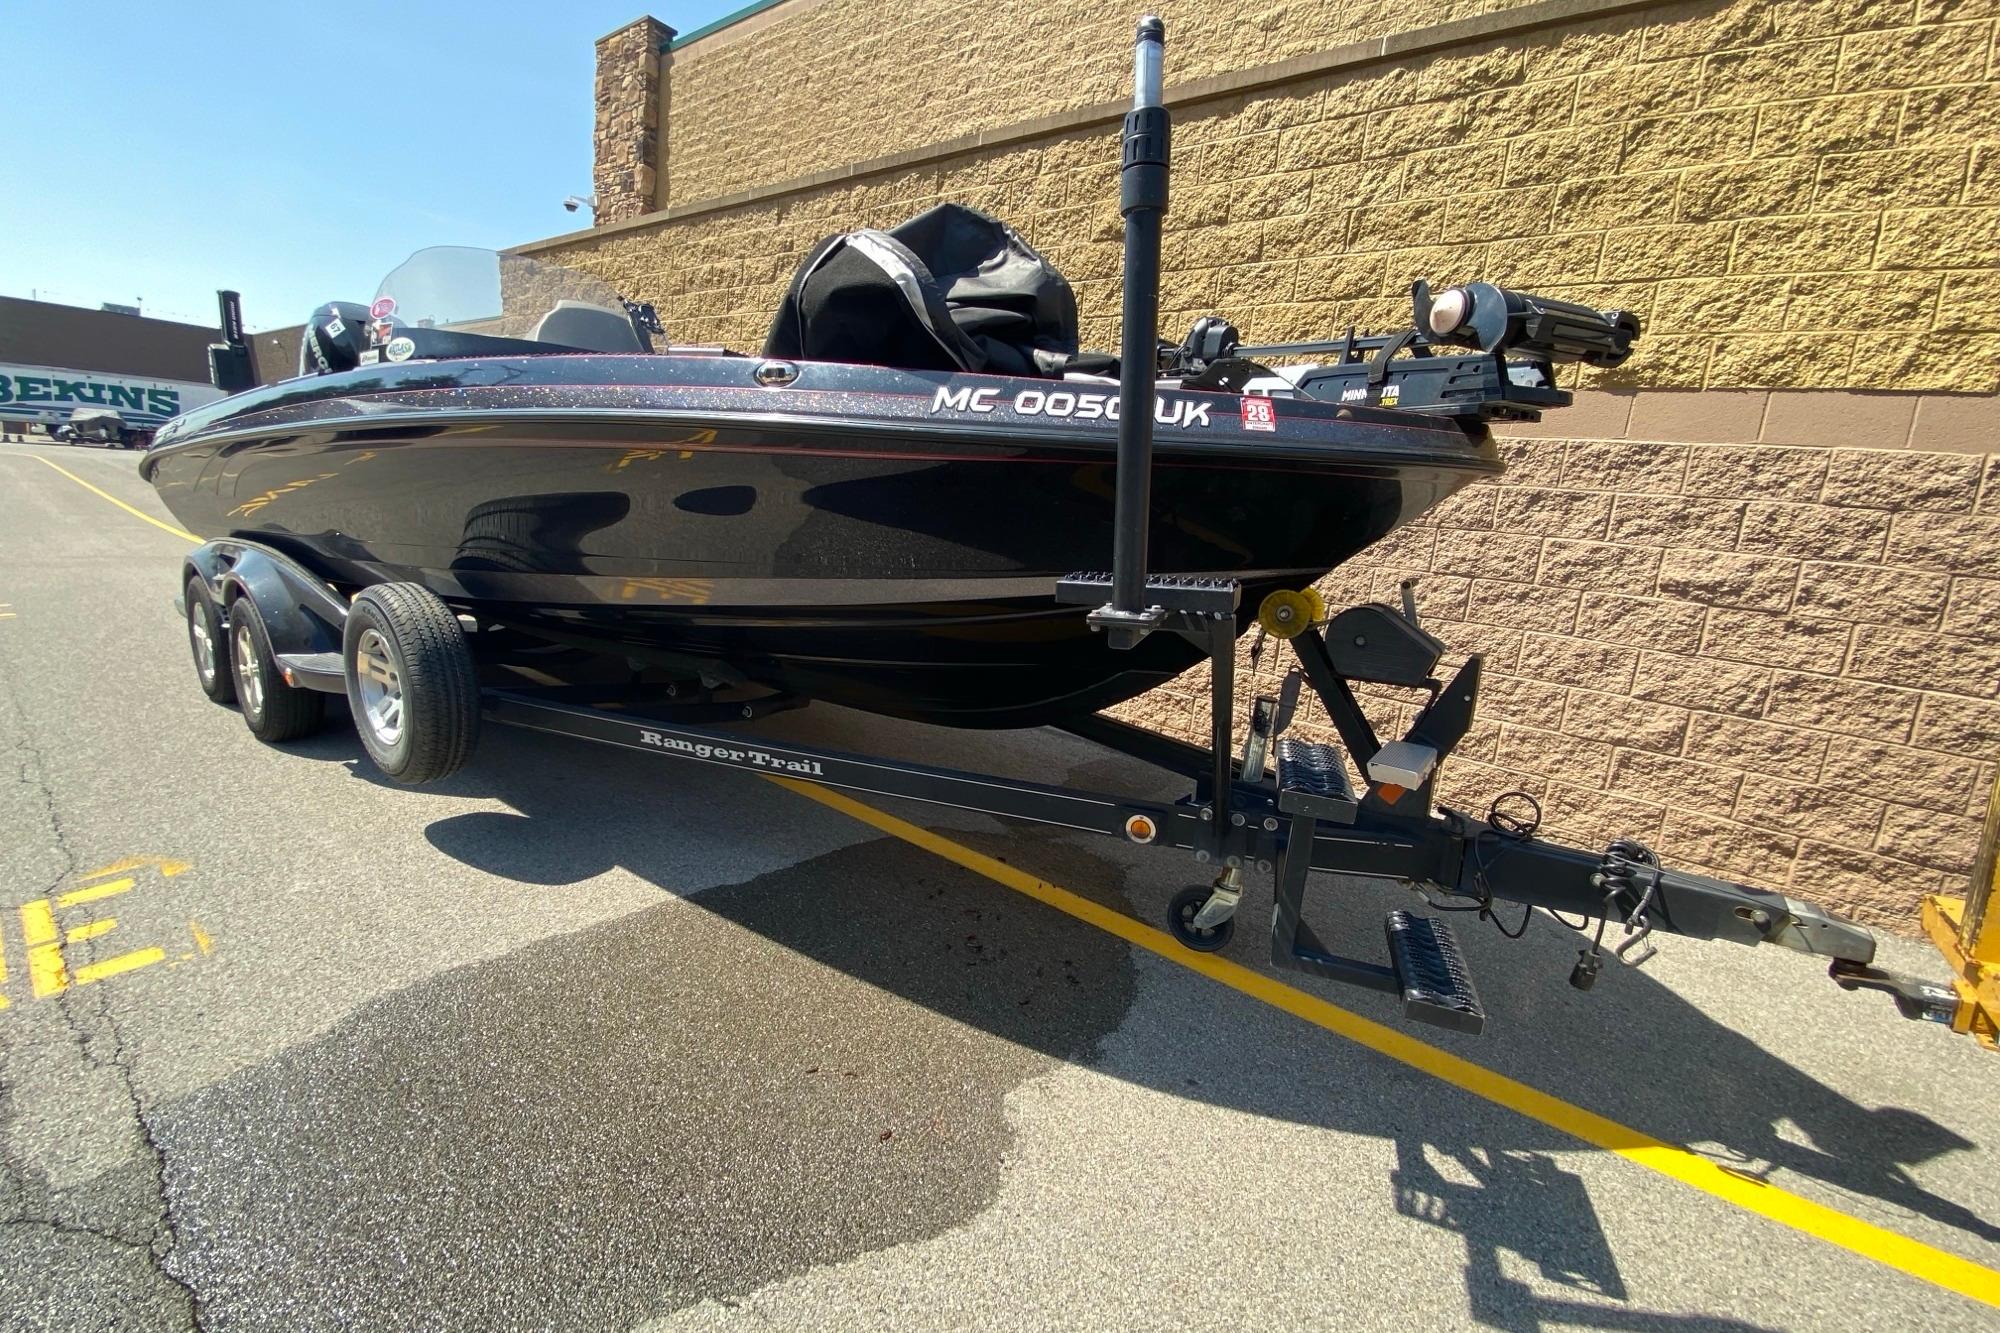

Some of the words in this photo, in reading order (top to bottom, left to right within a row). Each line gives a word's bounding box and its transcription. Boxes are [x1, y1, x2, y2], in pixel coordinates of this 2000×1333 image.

[0, 374, 181, 418] BEKINS
[930, 386, 1001, 415] MC
[1155, 396, 1213, 429] UK
[1246, 404, 1270, 422] 28
